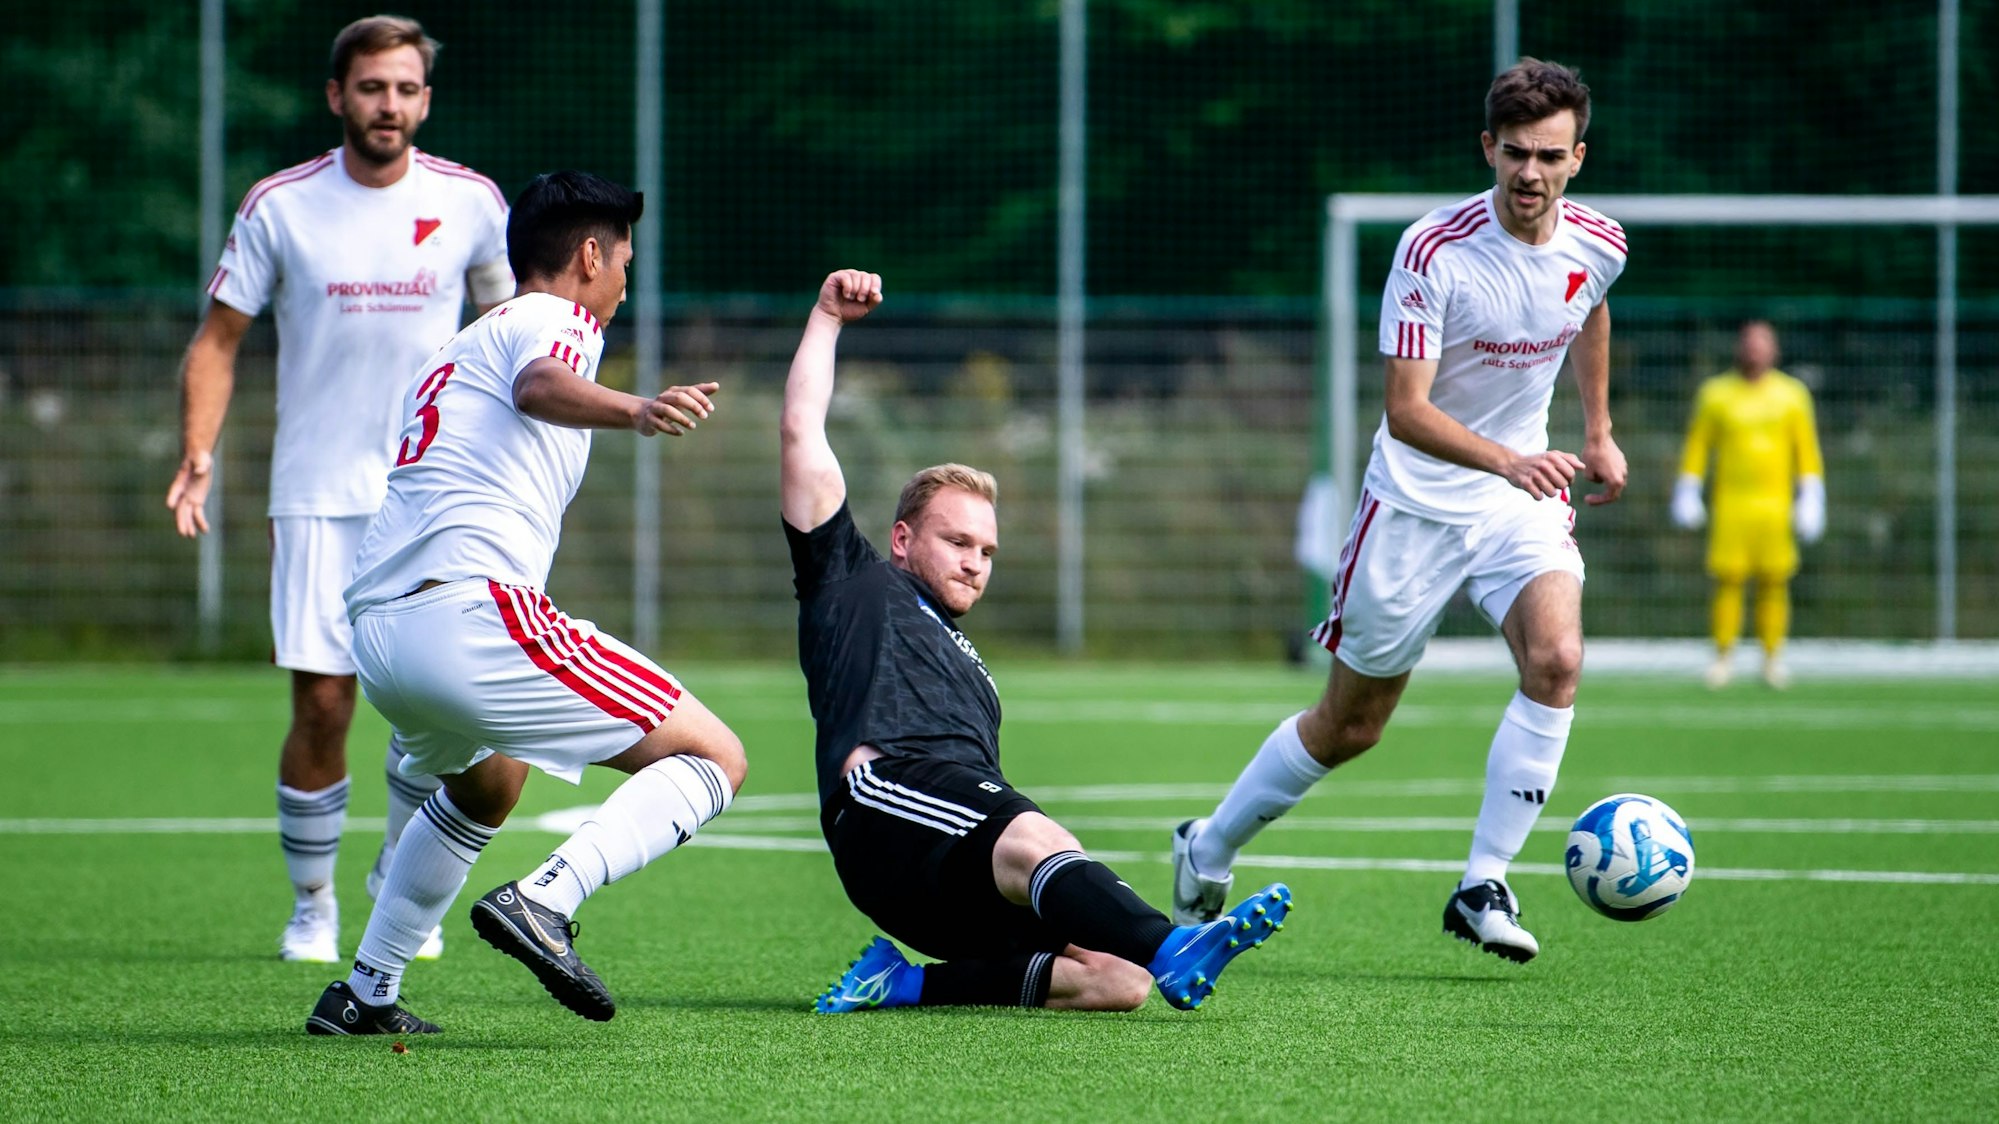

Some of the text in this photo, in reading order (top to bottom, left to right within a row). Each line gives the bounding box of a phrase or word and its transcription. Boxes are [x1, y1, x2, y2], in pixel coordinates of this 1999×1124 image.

[327, 282, 430, 297] PROVINZIAL
[1473, 335, 1567, 355] PROVINZIAL
[397, 363, 455, 467] 3
